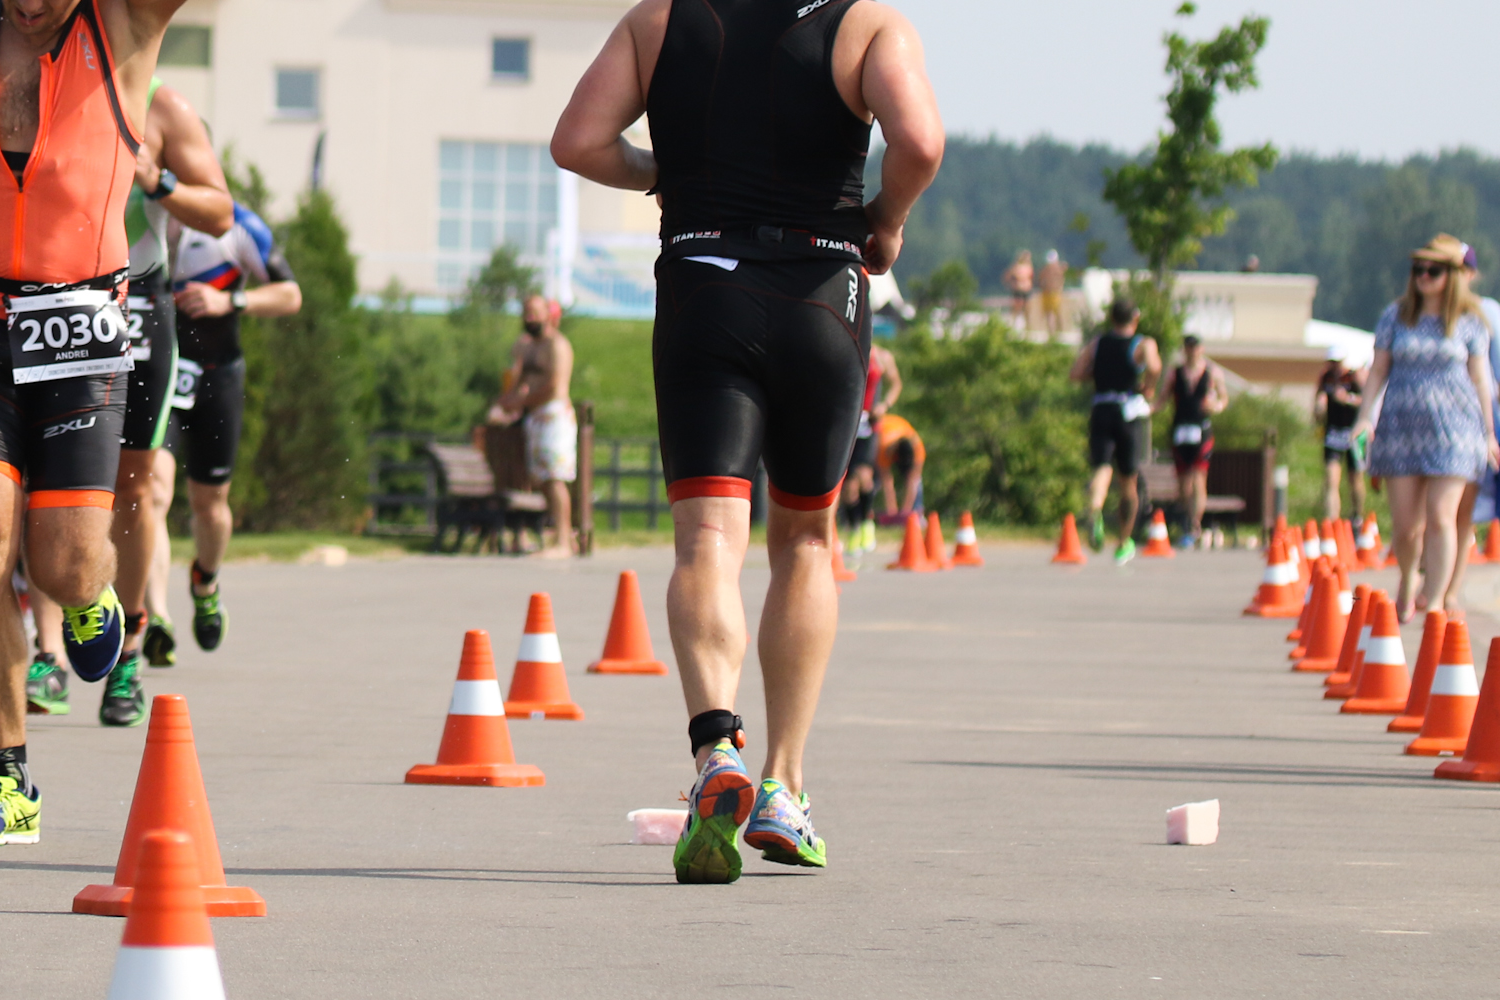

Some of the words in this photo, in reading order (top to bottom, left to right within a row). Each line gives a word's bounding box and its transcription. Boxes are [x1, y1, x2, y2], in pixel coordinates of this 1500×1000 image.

[845, 267, 859, 323] 2XU
[19, 312, 118, 352] 2030
[55, 349, 89, 361] ANDREI
[43, 415, 96, 439] 2XU
